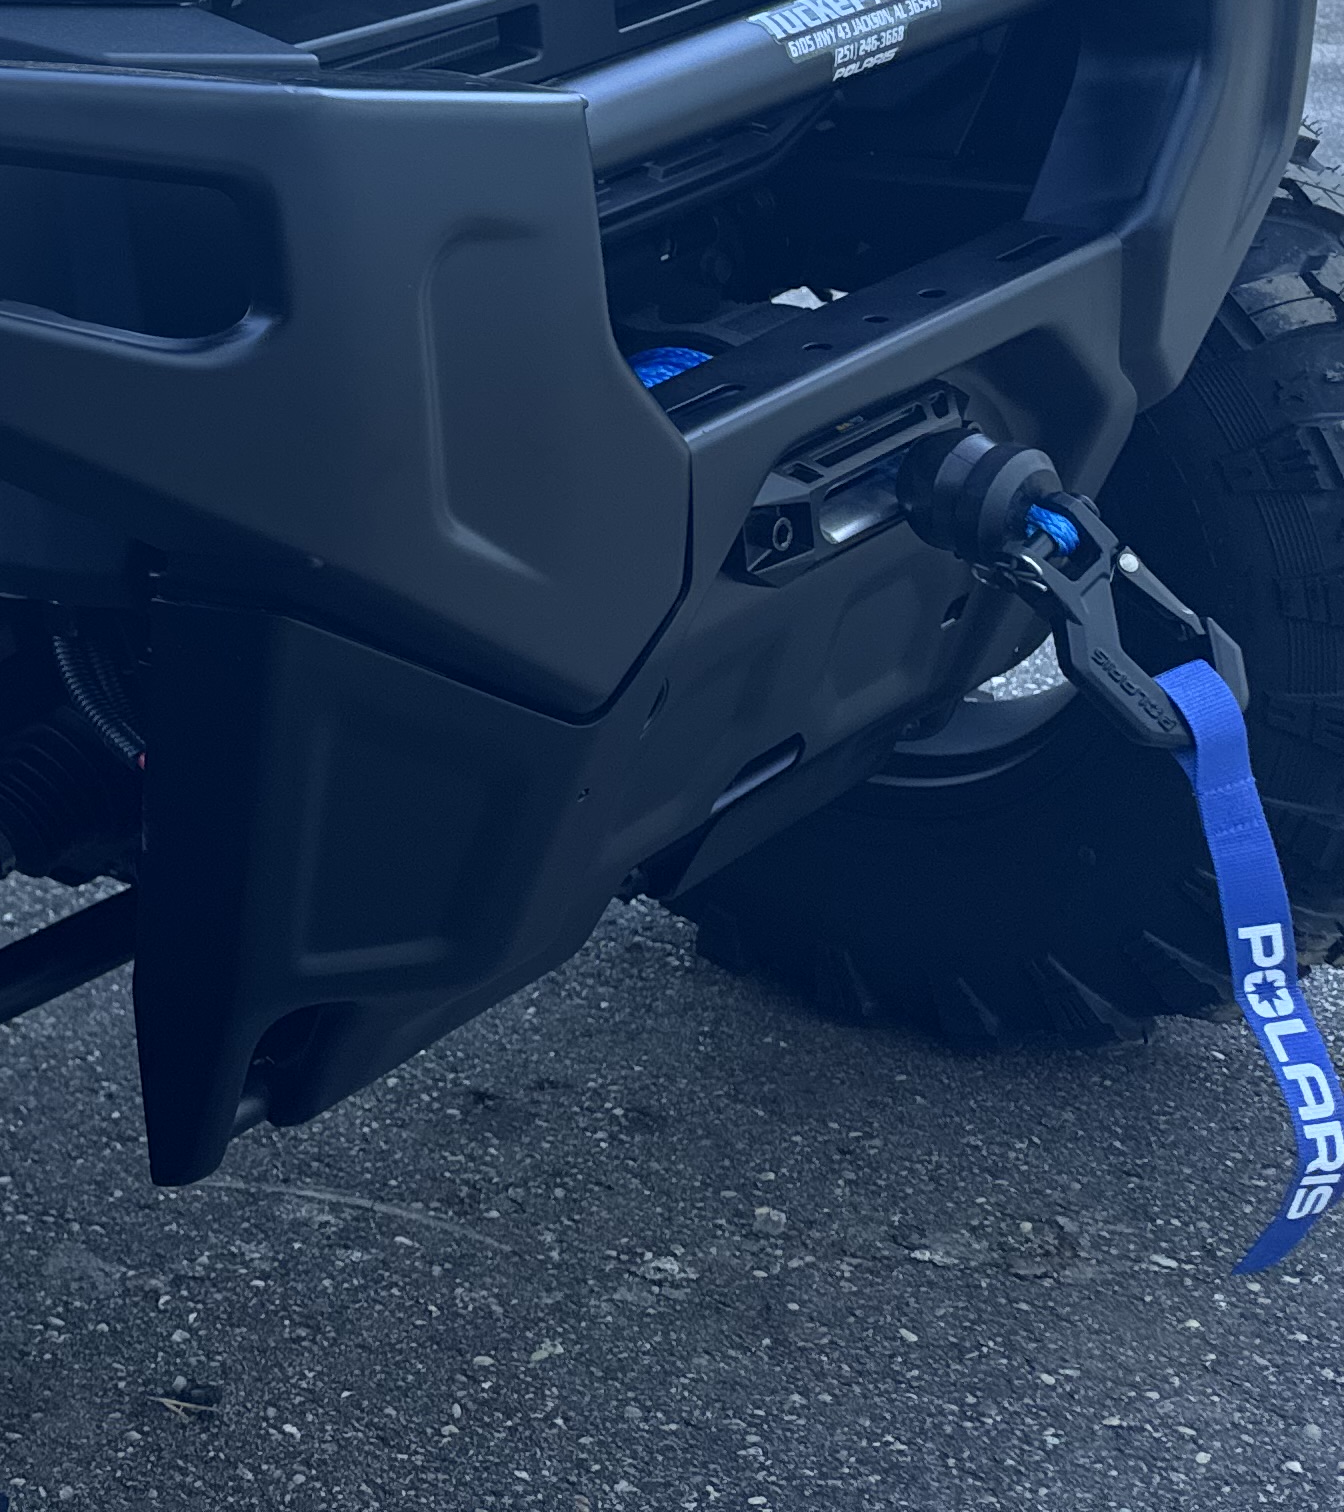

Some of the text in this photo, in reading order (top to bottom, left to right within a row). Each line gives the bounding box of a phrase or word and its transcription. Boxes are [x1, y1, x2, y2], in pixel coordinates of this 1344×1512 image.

[787, 35, 816, 58] 6105
[815, 27, 837, 49] HWY
[836, 24, 852, 40] 43
[893, 3, 908, 20] AL
[832, 47, 900, 82] POLARIS
[1237, 922, 1344, 1220] POLARIS
